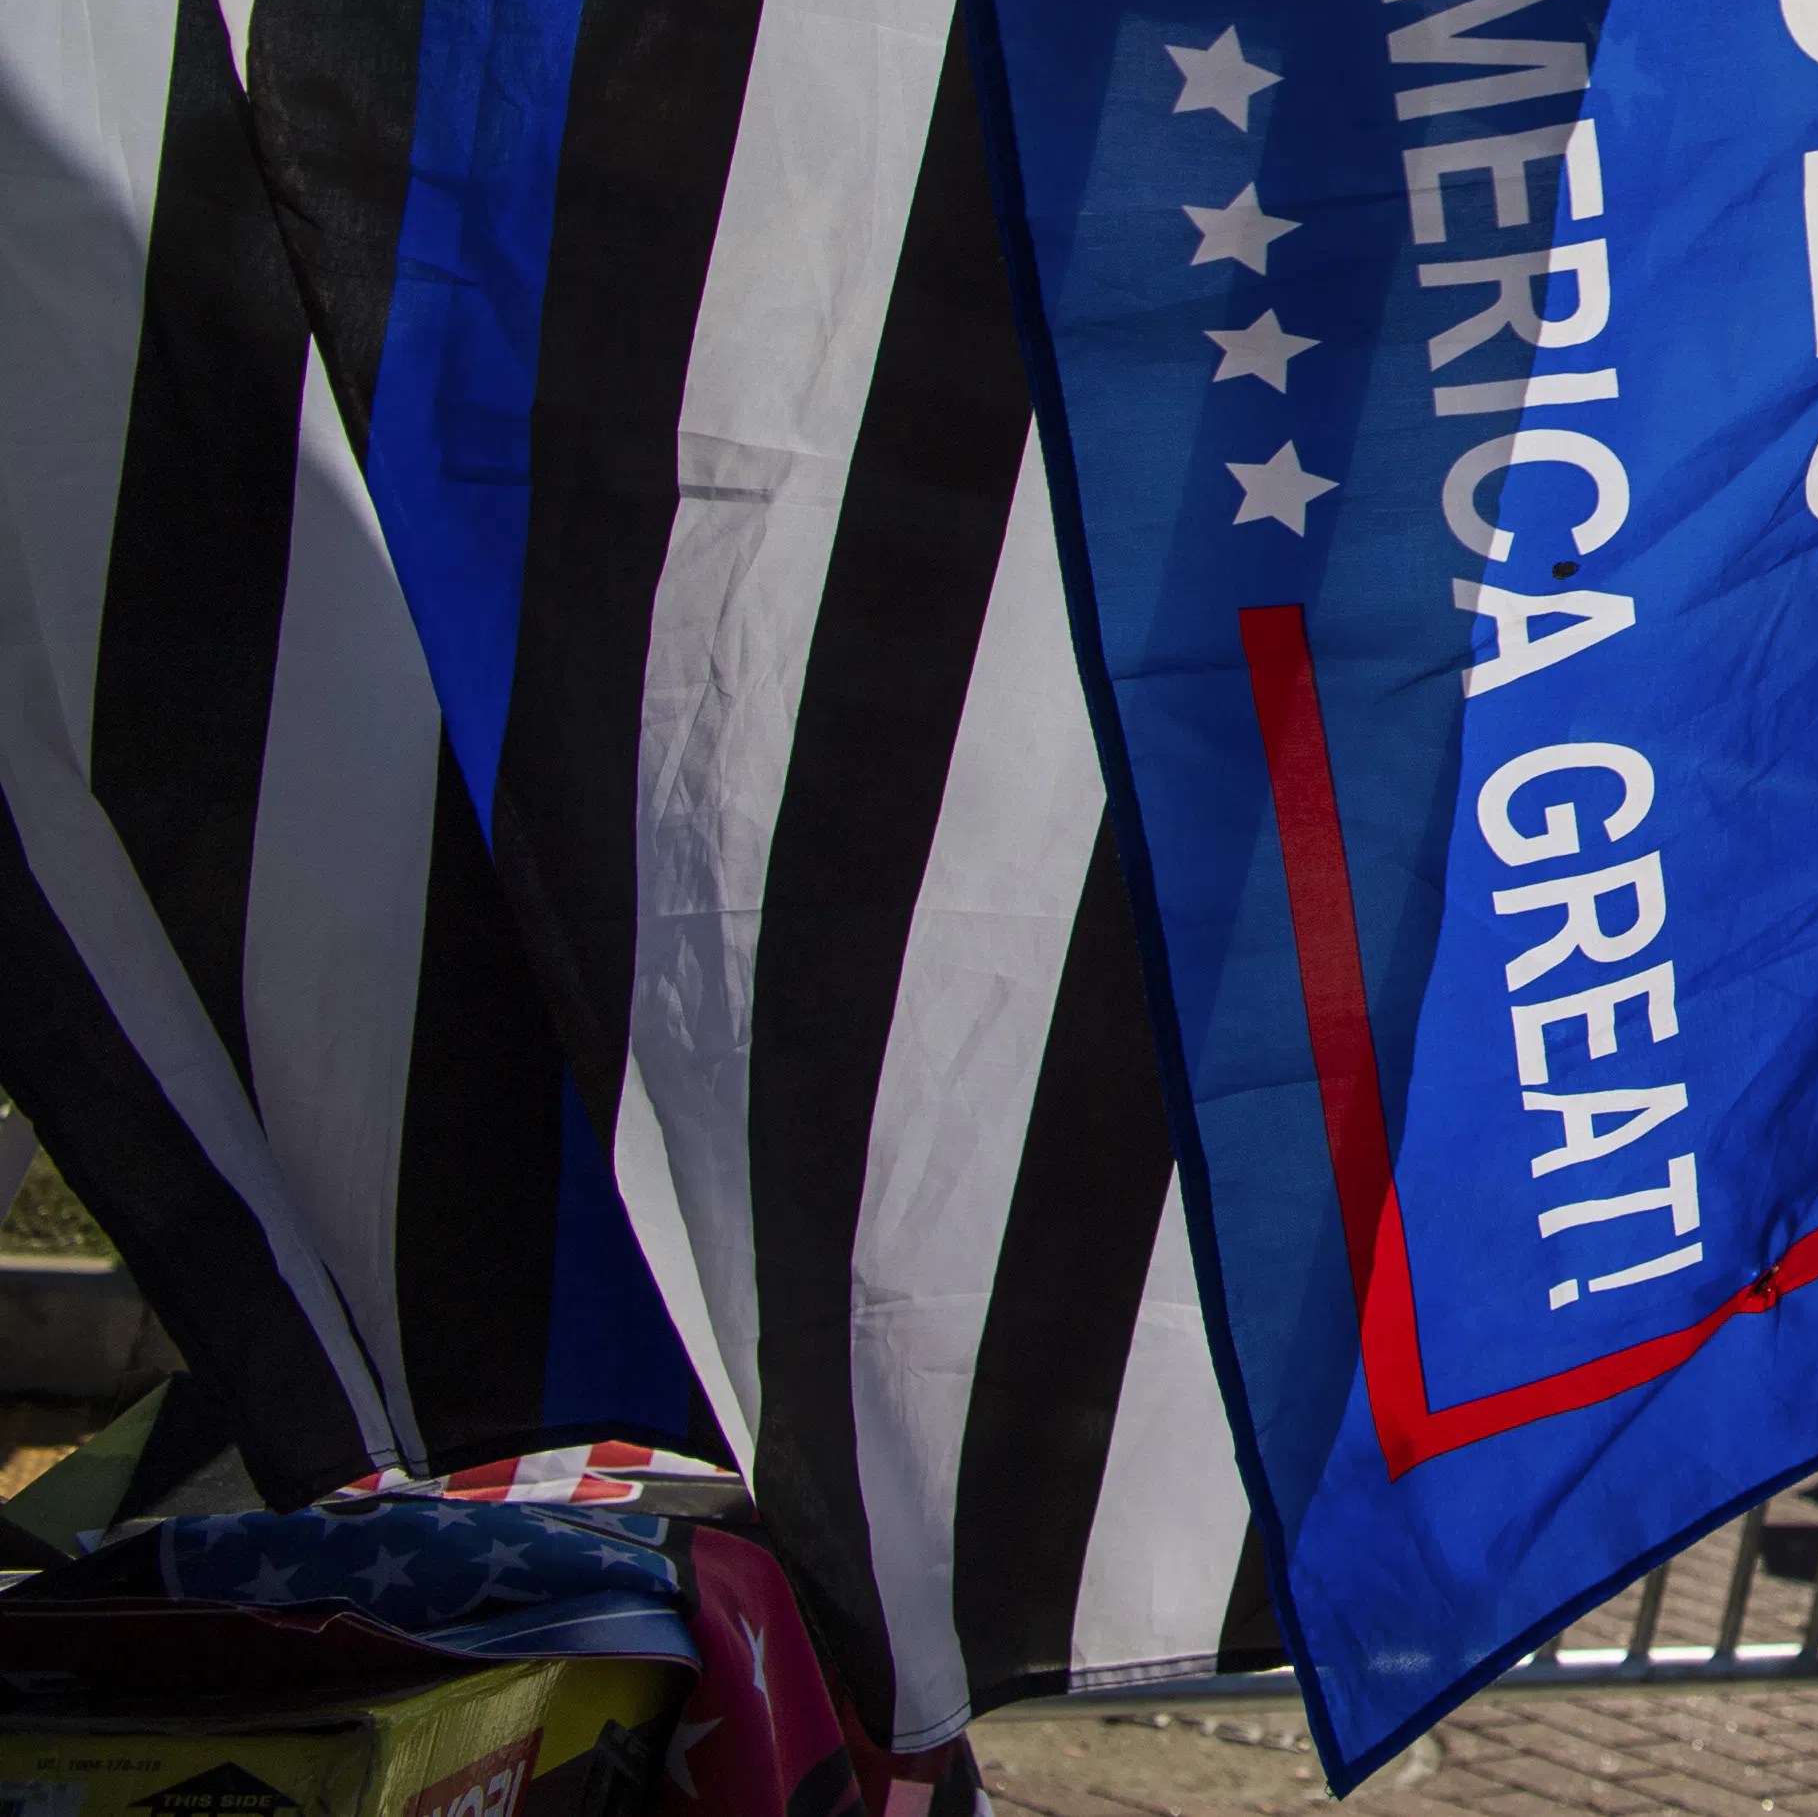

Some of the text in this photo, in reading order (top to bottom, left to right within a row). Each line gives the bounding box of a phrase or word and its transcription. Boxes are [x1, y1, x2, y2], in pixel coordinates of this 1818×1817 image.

[1475, 739, 1705, 1312] GREAT!
[162, 1793, 273, 1808] THIS SIDE
